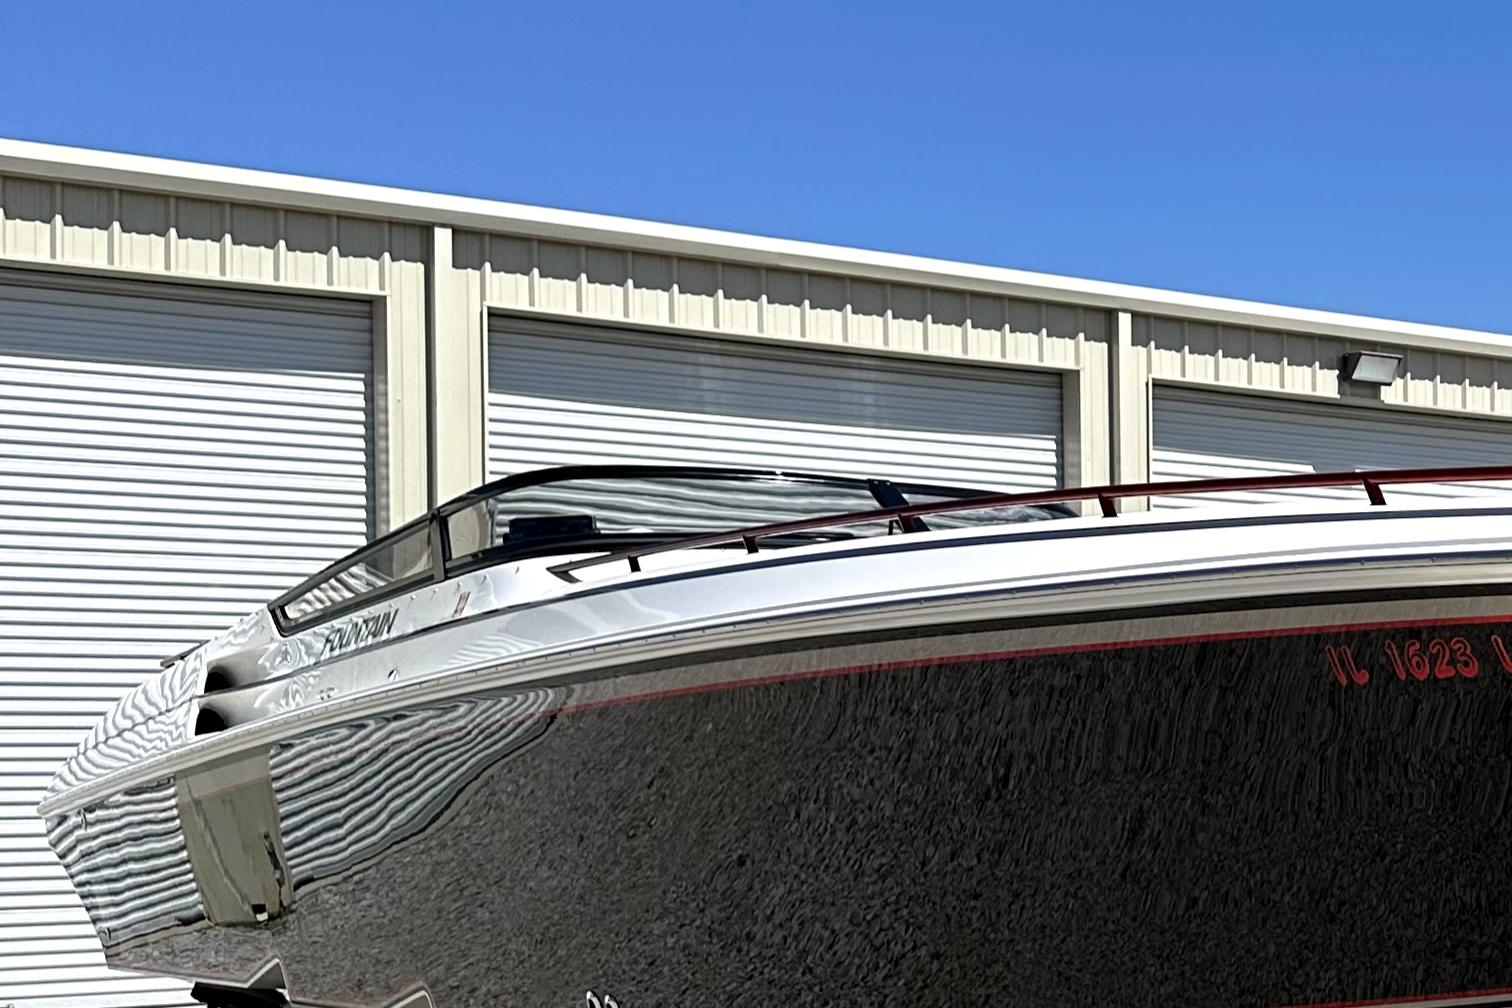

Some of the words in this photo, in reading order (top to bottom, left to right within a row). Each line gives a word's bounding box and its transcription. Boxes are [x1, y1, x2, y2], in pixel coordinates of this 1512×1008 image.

[321, 608, 399, 656] FOUNTAIN
[1325, 644, 1370, 687] IL
[1384, 637, 1479, 681] 1623
